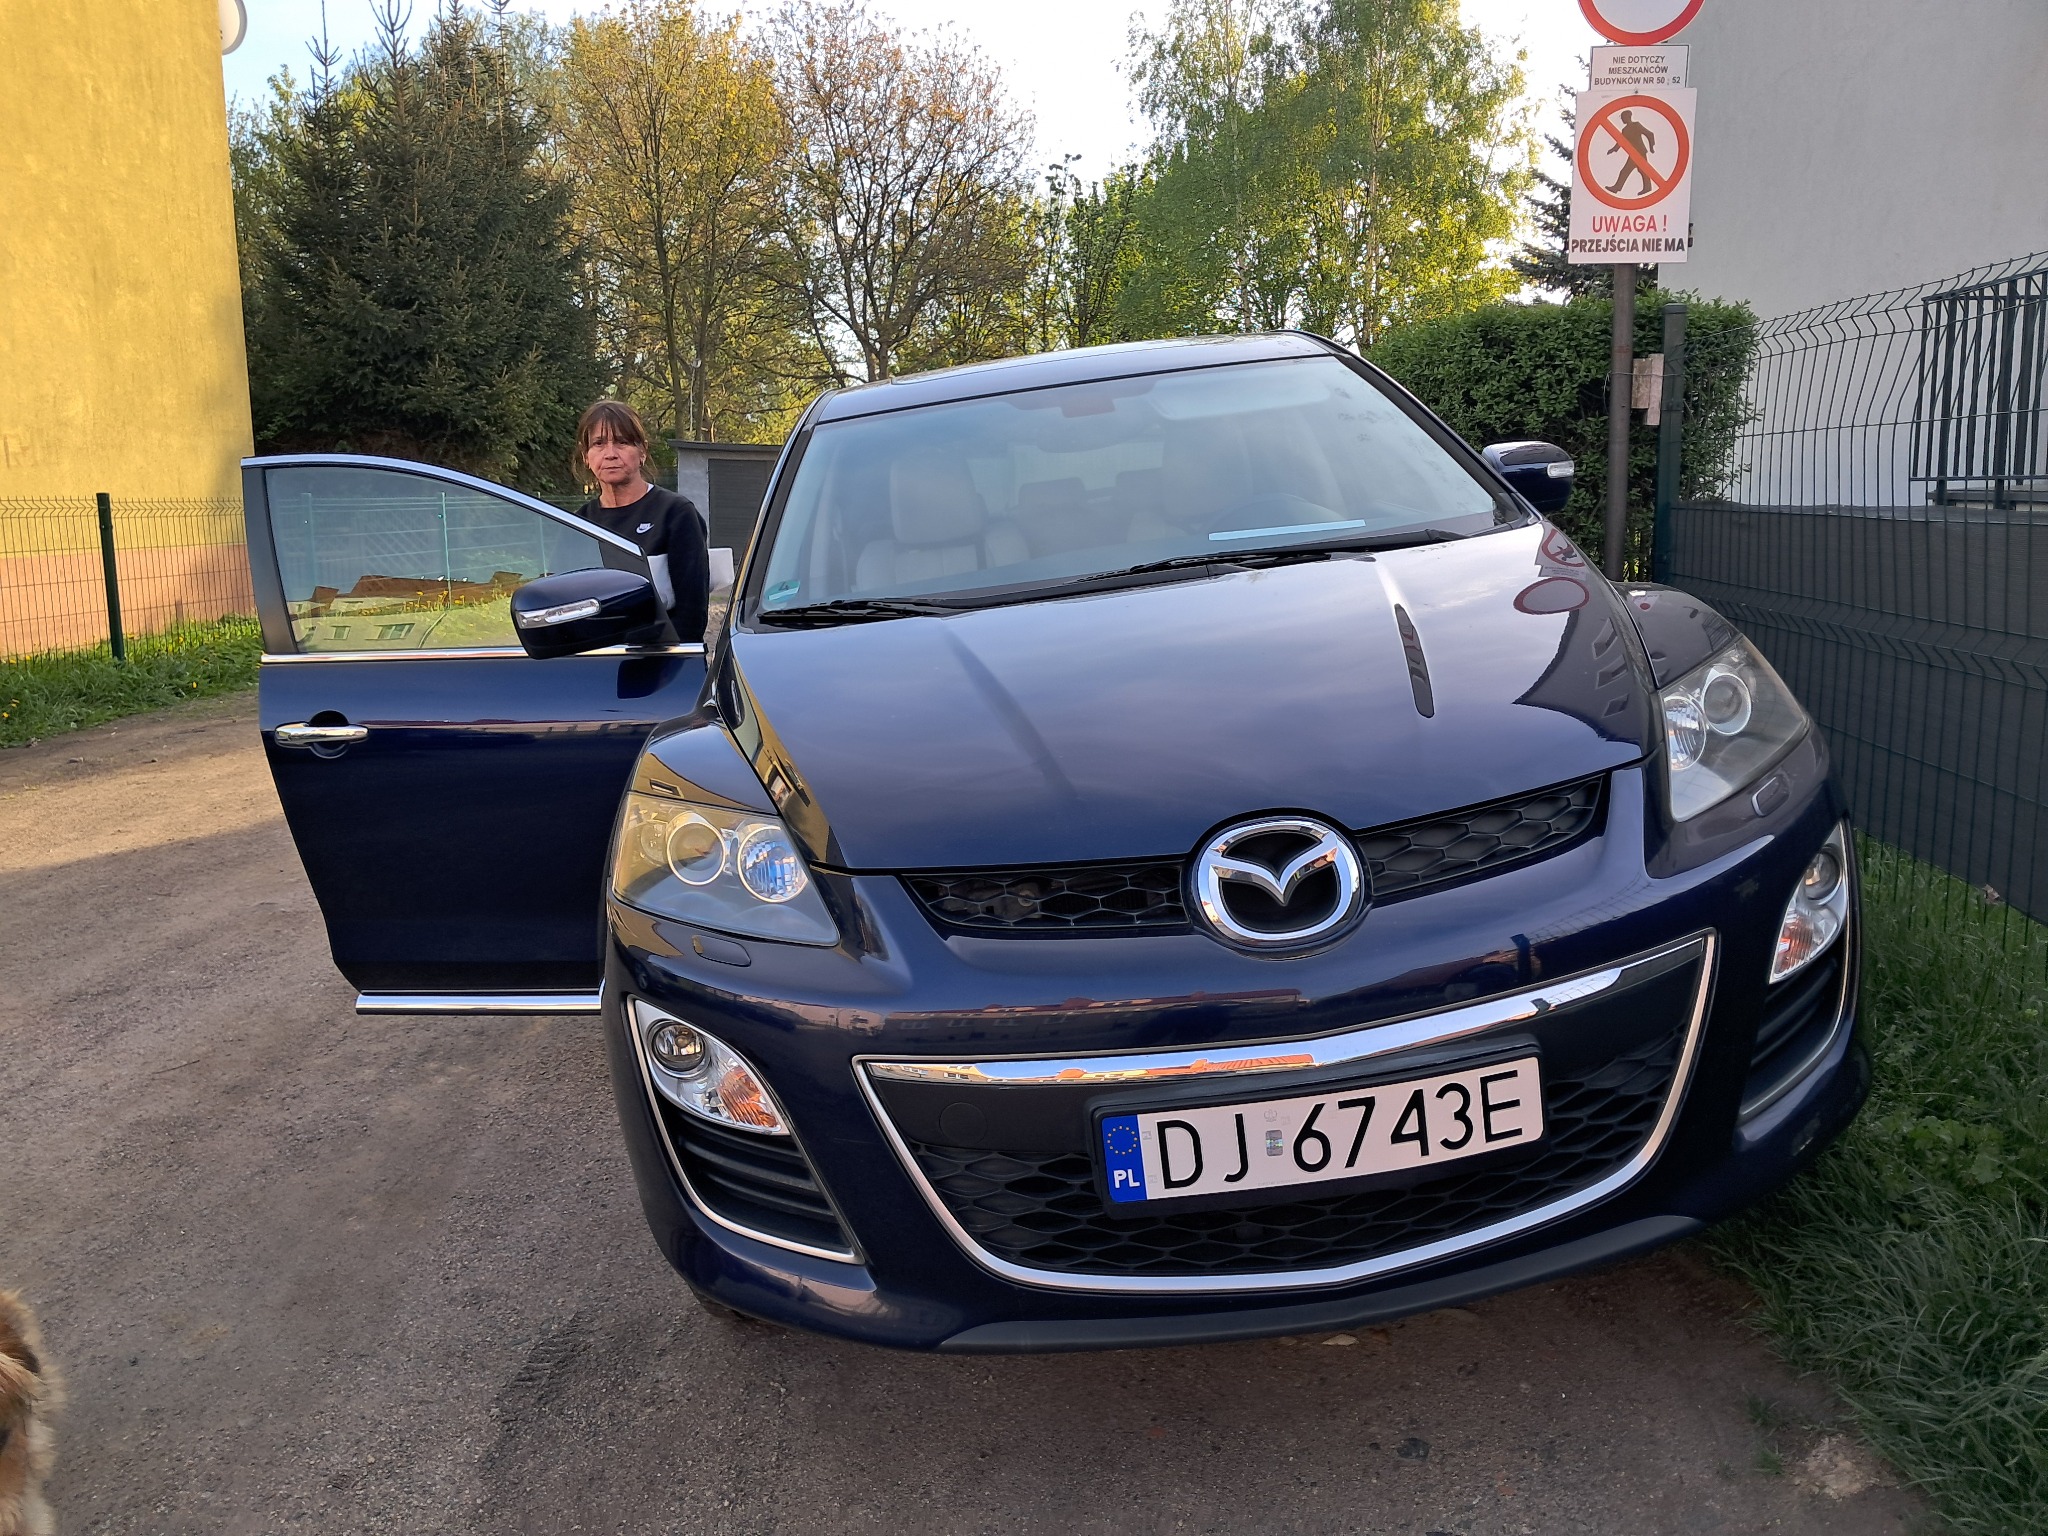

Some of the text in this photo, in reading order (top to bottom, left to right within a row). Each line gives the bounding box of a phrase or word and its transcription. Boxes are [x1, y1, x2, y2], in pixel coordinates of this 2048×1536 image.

[1612, 55, 1666, 64] NIE DOTYCZY
[1608, 65, 1668, 75] MIESZKAŃCÓW
[1594, 76, 1641, 86] BUDYNKÓW
[1642, 76, 1654, 84] NR
[1656, 76, 1665, 84] 50
[1672, 76, 1681, 84] 52
[1592, 214, 1658, 233] UWAGA
[1571, 234, 1686, 253] PRZEJŚCIA NIE MA
[1292, 1069, 1523, 1173] 6743E
[1113, 1168, 1141, 1189] PL
